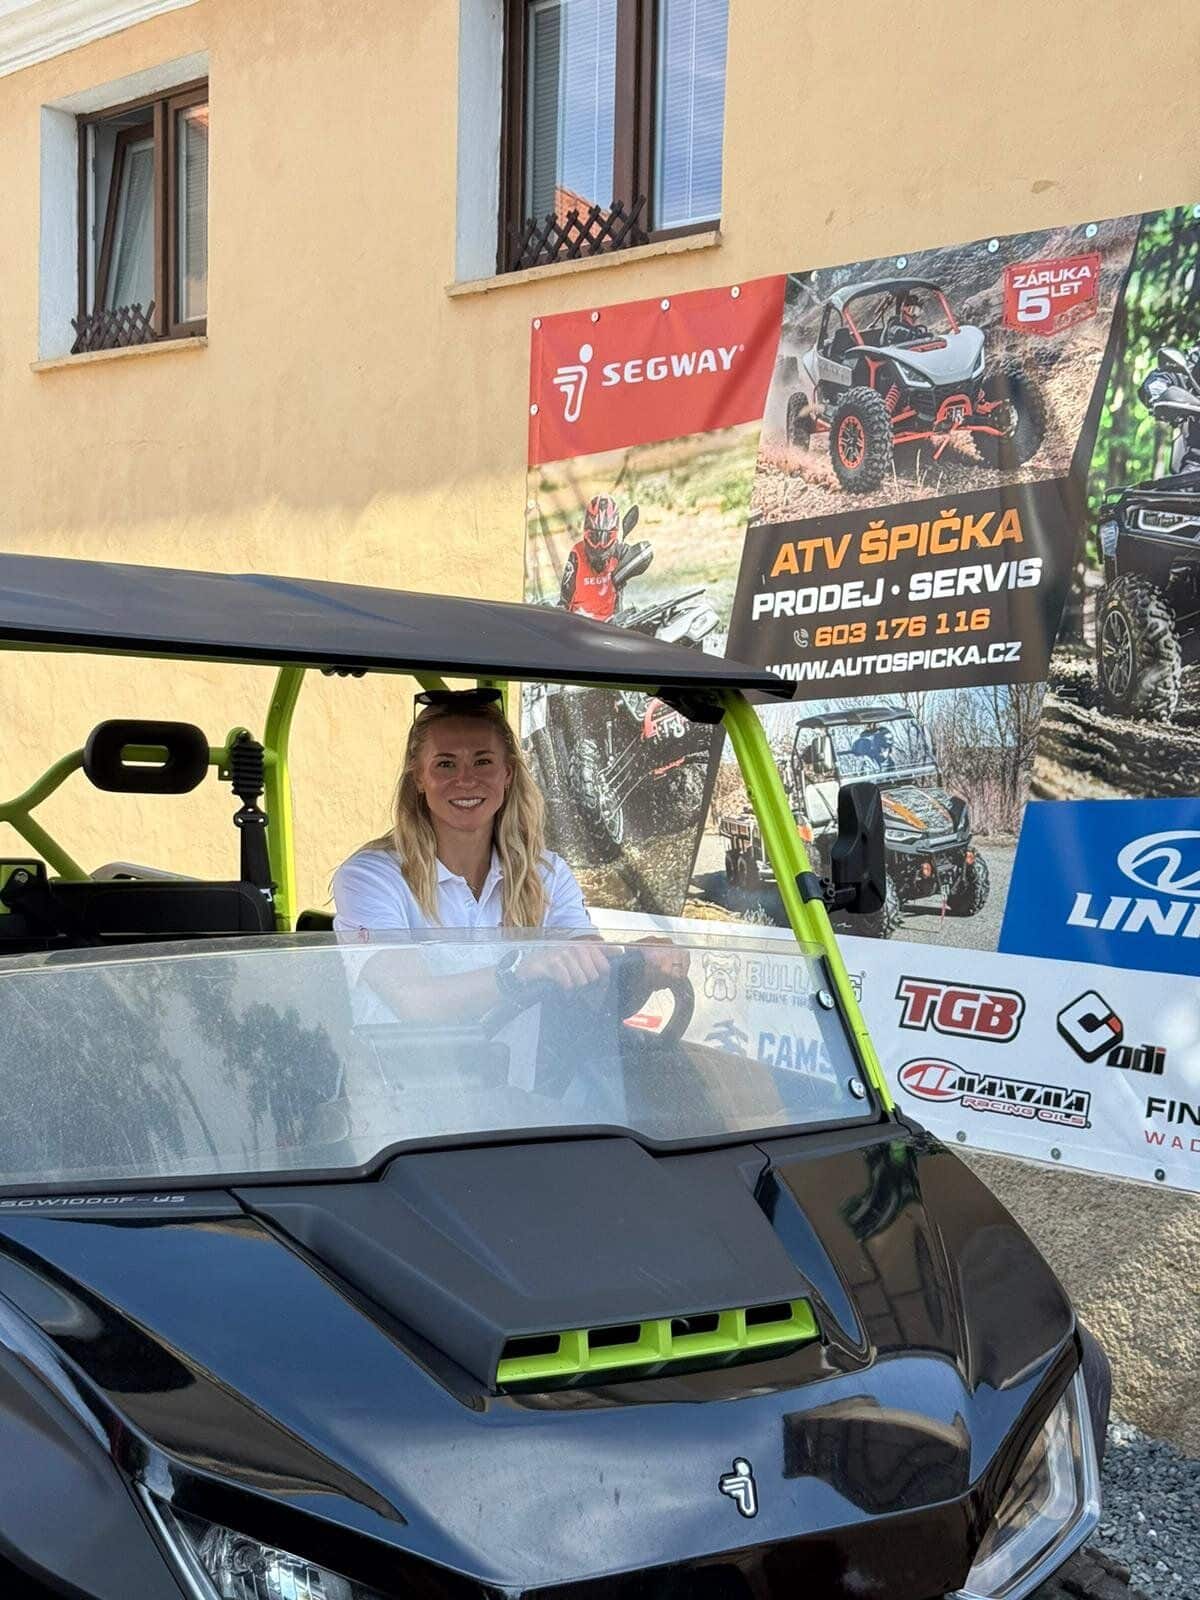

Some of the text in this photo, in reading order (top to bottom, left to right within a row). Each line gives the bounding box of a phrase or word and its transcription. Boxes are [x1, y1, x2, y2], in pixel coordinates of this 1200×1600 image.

[1012, 265, 1092, 288] ZÁRUKA
[1017, 281, 1083, 322] 5 LET
[601, 344, 738, 387] SEGWAY
[769, 508, 1024, 578] ATV ŠPIČKA
[751, 556, 1043, 621] PRODEJ SERVIS
[814, 608, 991, 648] 603 176 116
[765, 641, 1022, 682] WWW.AUTOSPICKA.CZ
[900, 981, 1020, 1038] TGB
[947, 1075, 1088, 1113] MAXIMA
[1039, 1110, 1085, 1125] OILS
